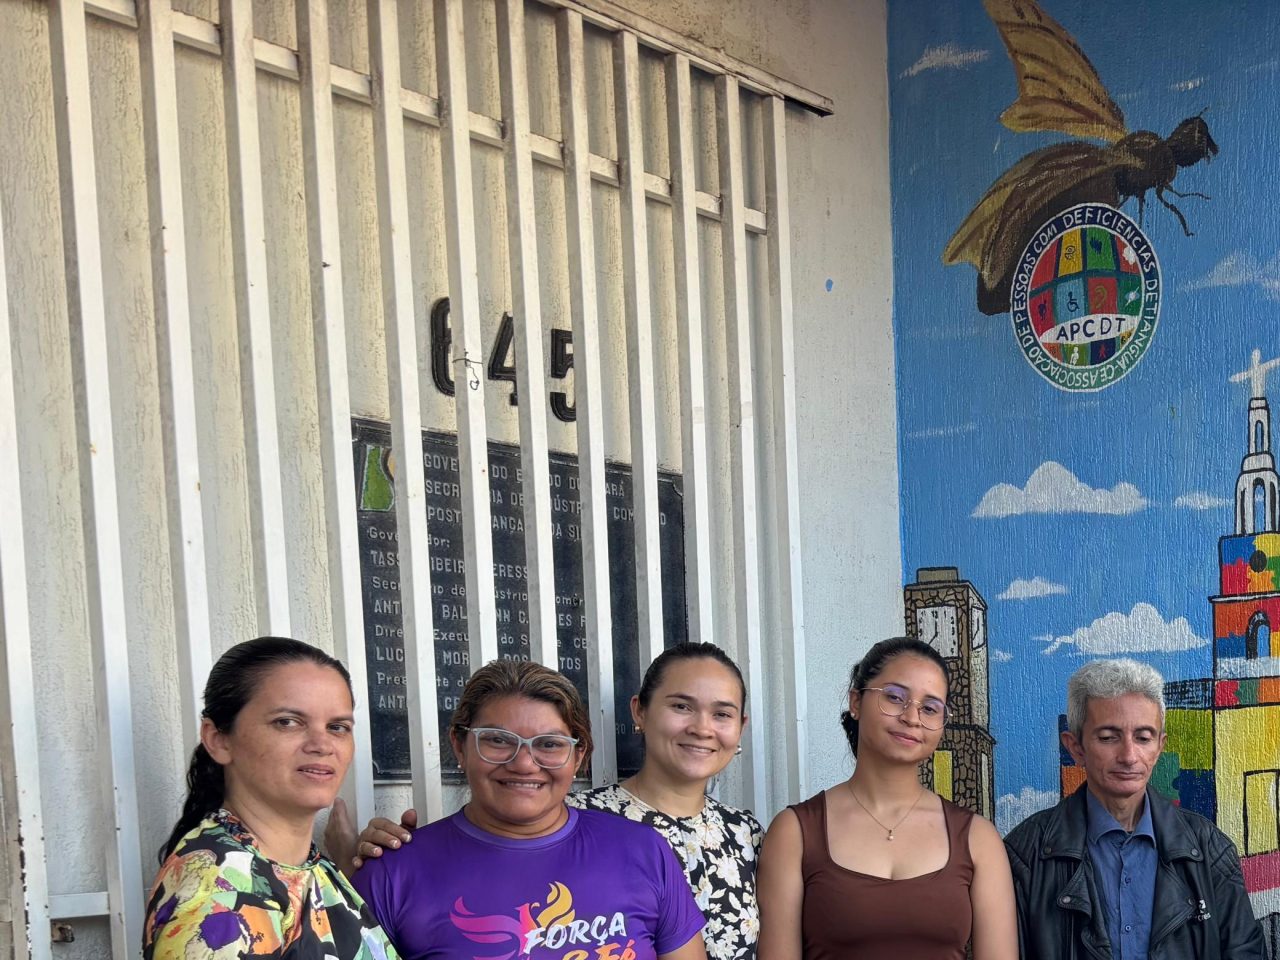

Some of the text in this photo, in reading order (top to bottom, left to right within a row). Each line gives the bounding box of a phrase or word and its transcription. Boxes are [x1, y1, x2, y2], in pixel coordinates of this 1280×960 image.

[1033, 227, 1058, 251] COM
[1062, 208, 1155, 272] DEFICIENCIAS
[1013, 252, 1037, 322] PESSOAS
[1145, 278, 1158, 302] DE
[1018, 325, 1034, 348] DE
[1056, 317, 1126, 341] APCDT
[492, 465, 508, 479] DO
[451, 584, 466, 596] de
[501, 633, 514, 644] do
[523, 911, 627, 955] FORÇA
